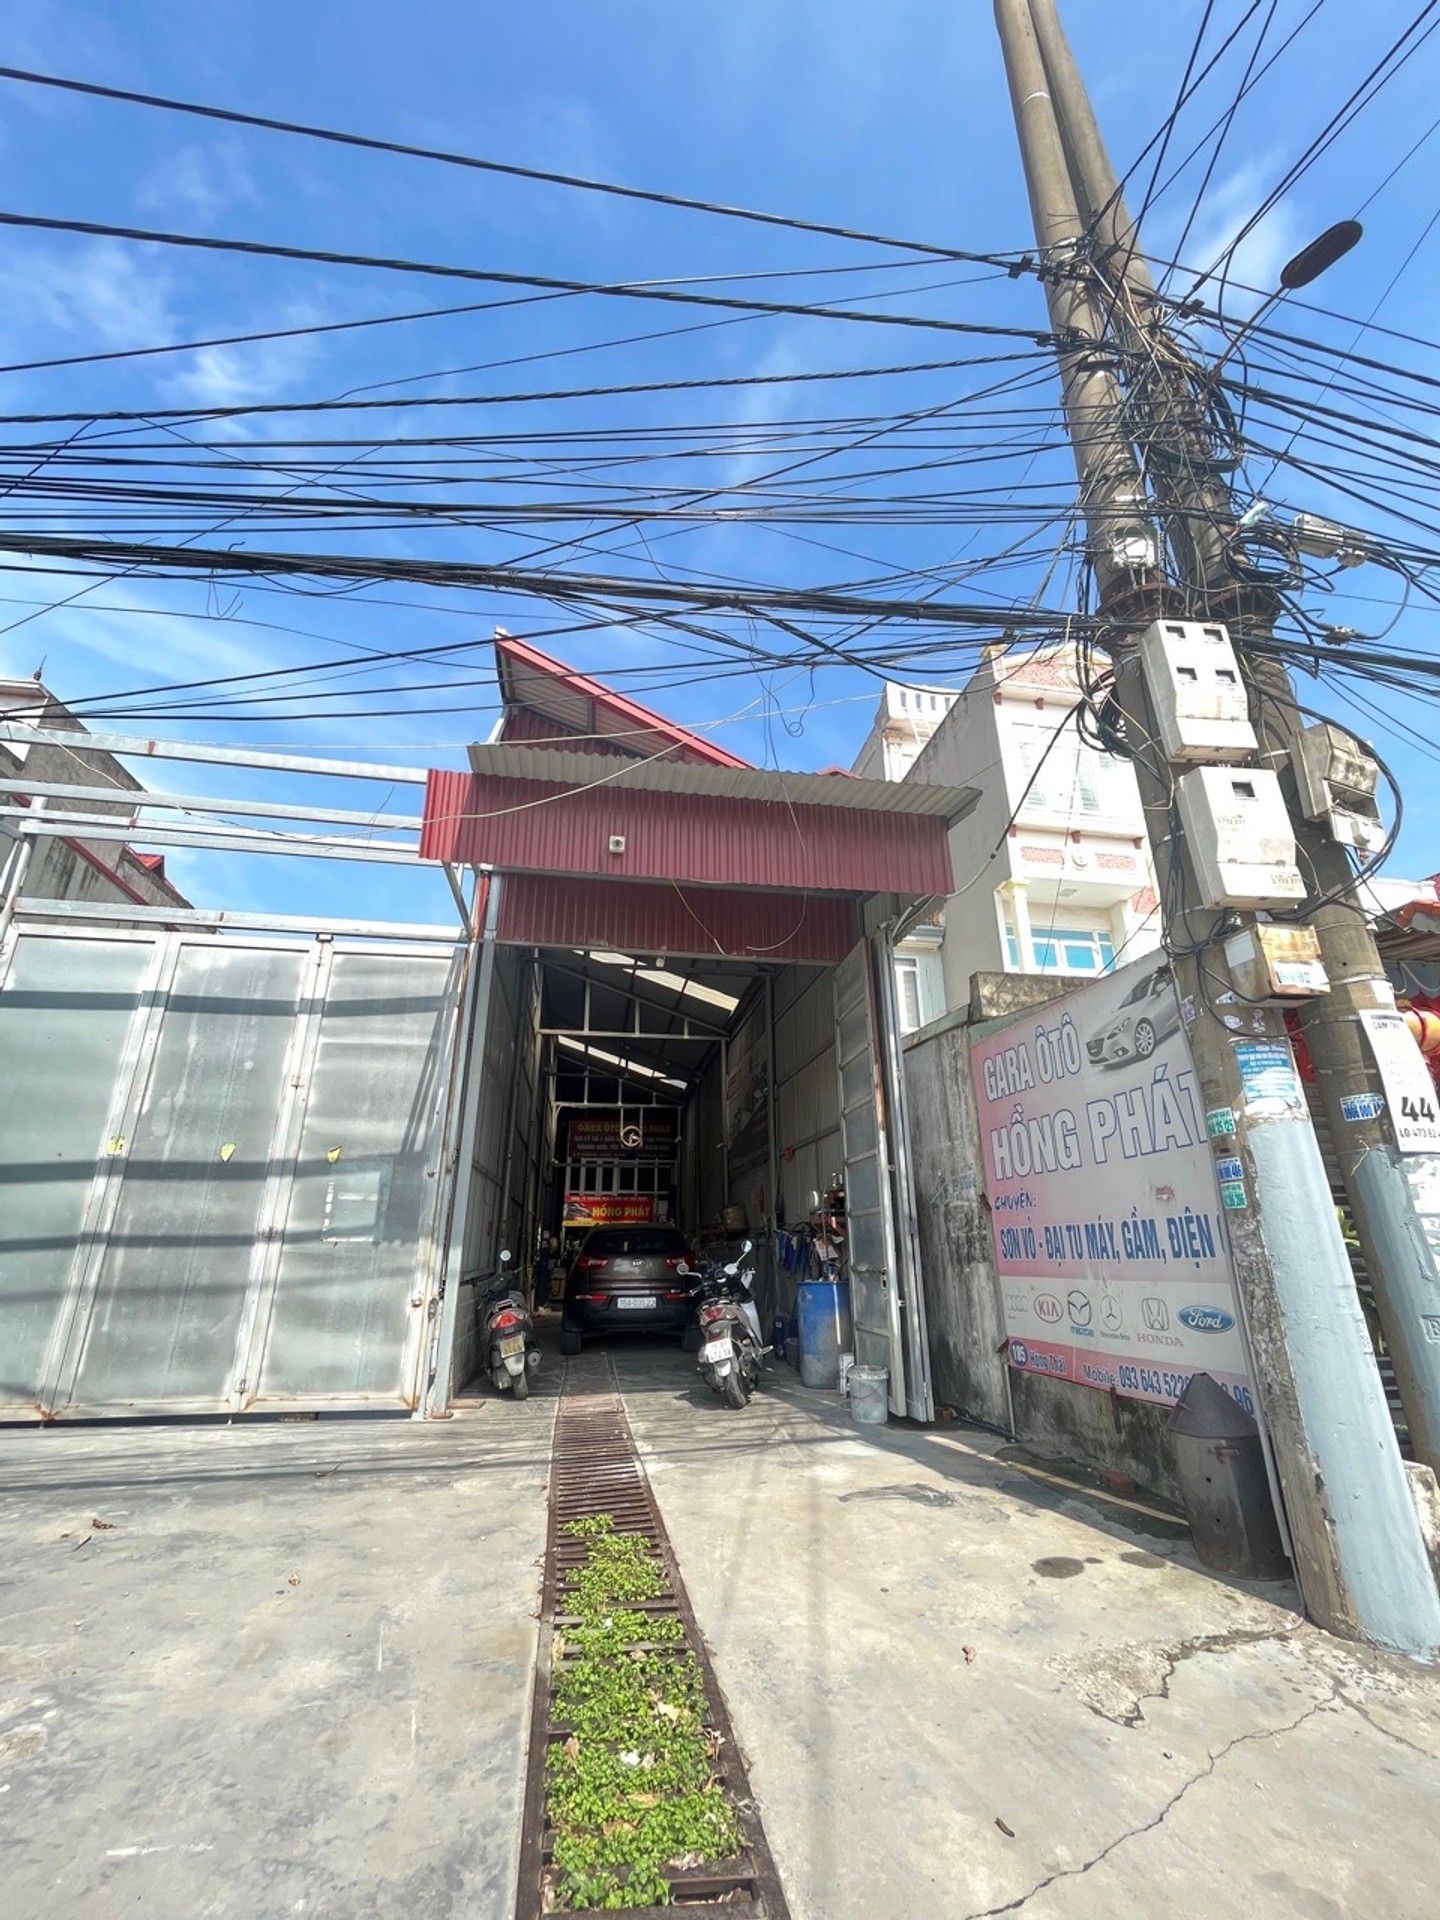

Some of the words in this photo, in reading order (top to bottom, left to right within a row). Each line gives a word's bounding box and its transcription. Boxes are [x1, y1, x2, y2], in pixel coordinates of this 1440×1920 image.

[983, 1043, 1035, 1102] GARA
[1035, 1012, 1082, 1084] ÔTÔ
[991, 1103, 1082, 1181] HỒNG
[1086, 1062, 1208, 1164] PHÁT
[1401, 1096, 1435, 1123] 44
[1084, 1214, 1121, 1265] MÁY,
[1121, 1205, 1167, 1265] GẦM,
[1166, 1205, 1217, 1269] ĐIỆN
[1137, 1333, 1184, 1347] HONDA
[1119, 1365, 1139, 1390] 093
[1140, 1369, 1162, 1396] 643
